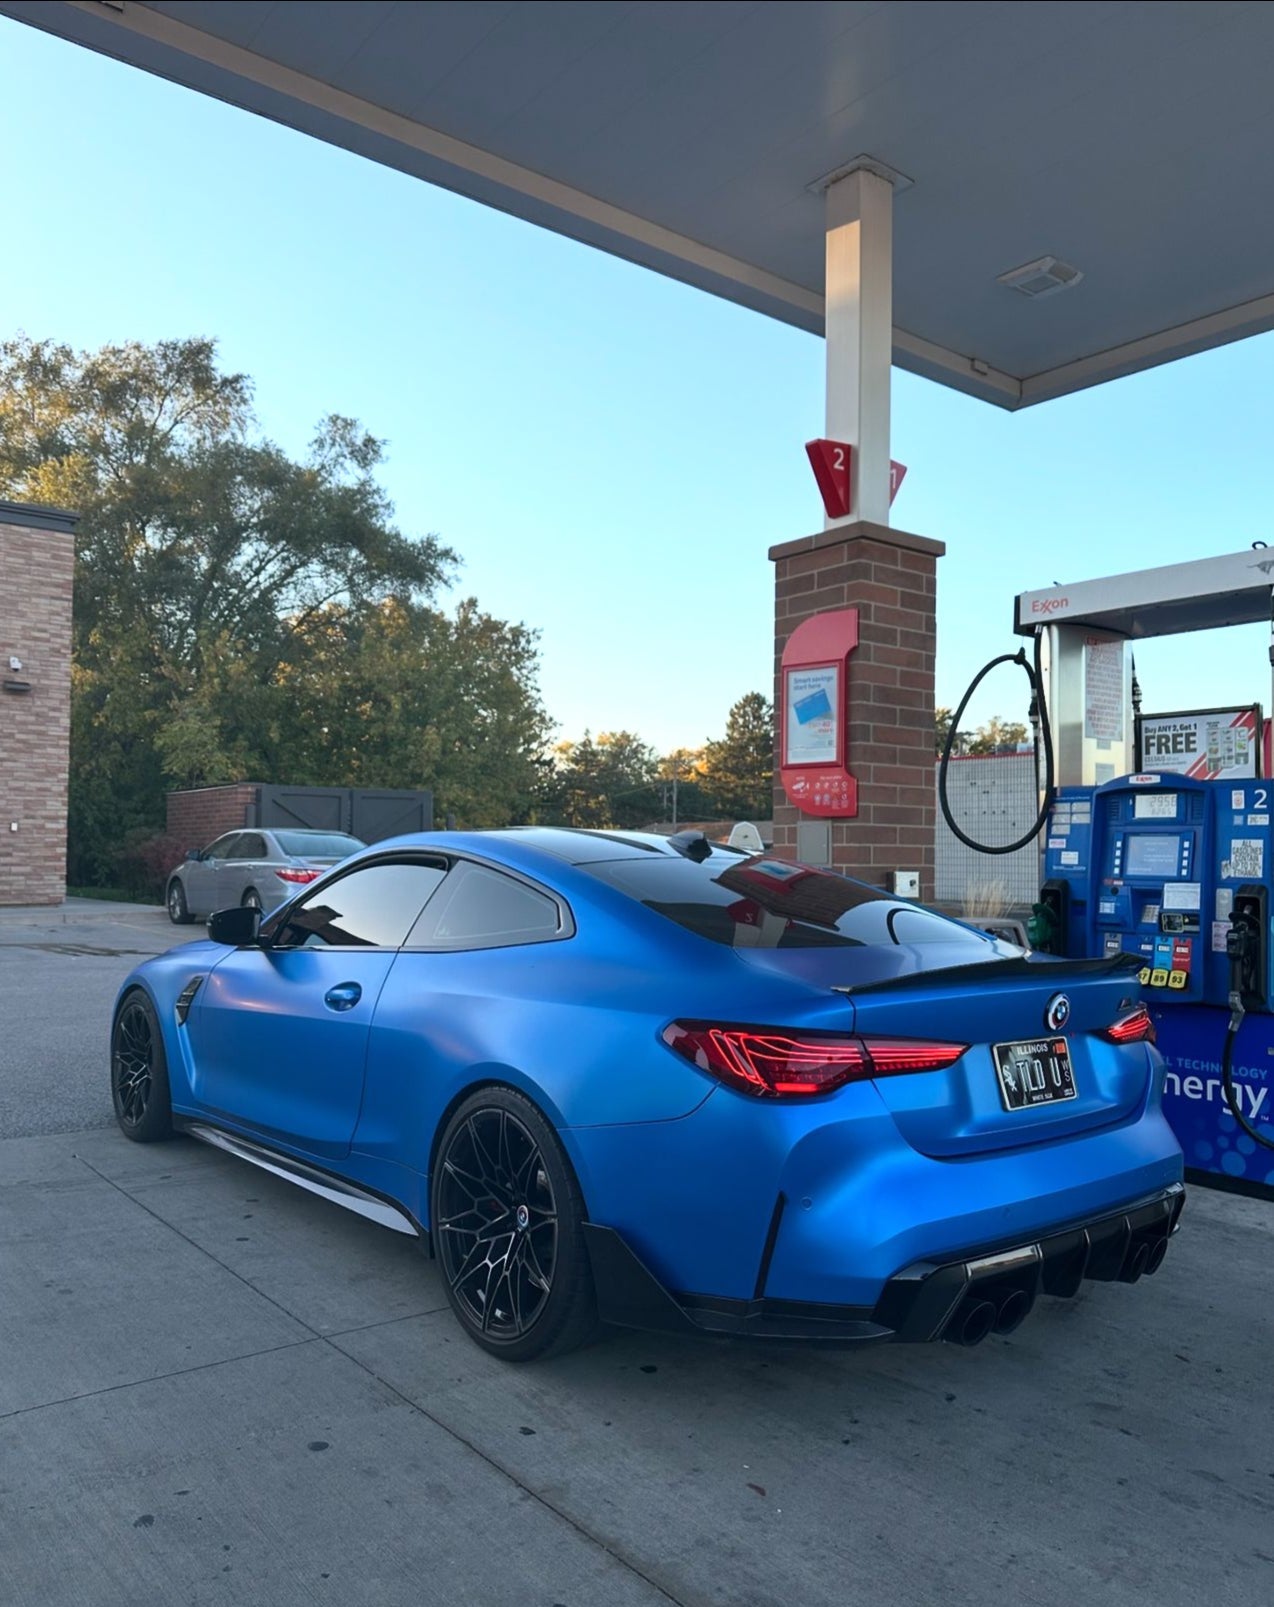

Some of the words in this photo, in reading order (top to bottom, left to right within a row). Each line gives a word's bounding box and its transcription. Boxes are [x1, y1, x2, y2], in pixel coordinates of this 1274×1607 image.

[833, 448, 845, 471] 2
[890, 468, 897, 489] 1
[1032, 598, 1069, 614] Exxon
[1144, 726, 1157, 734] Buy
[1179, 723, 1191, 731] Get
[1193, 722, 1197, 730] 1
[1144, 732, 1197, 755] FREE
[1253, 789, 1267, 809] 2
[1153, 974, 1164, 982] 89
[1171, 975, 1183, 984] 93
[1016, 1043, 1049, 1055] ILLINOIS
[1176, 1057, 1268, 1080] TECHNLOGY
